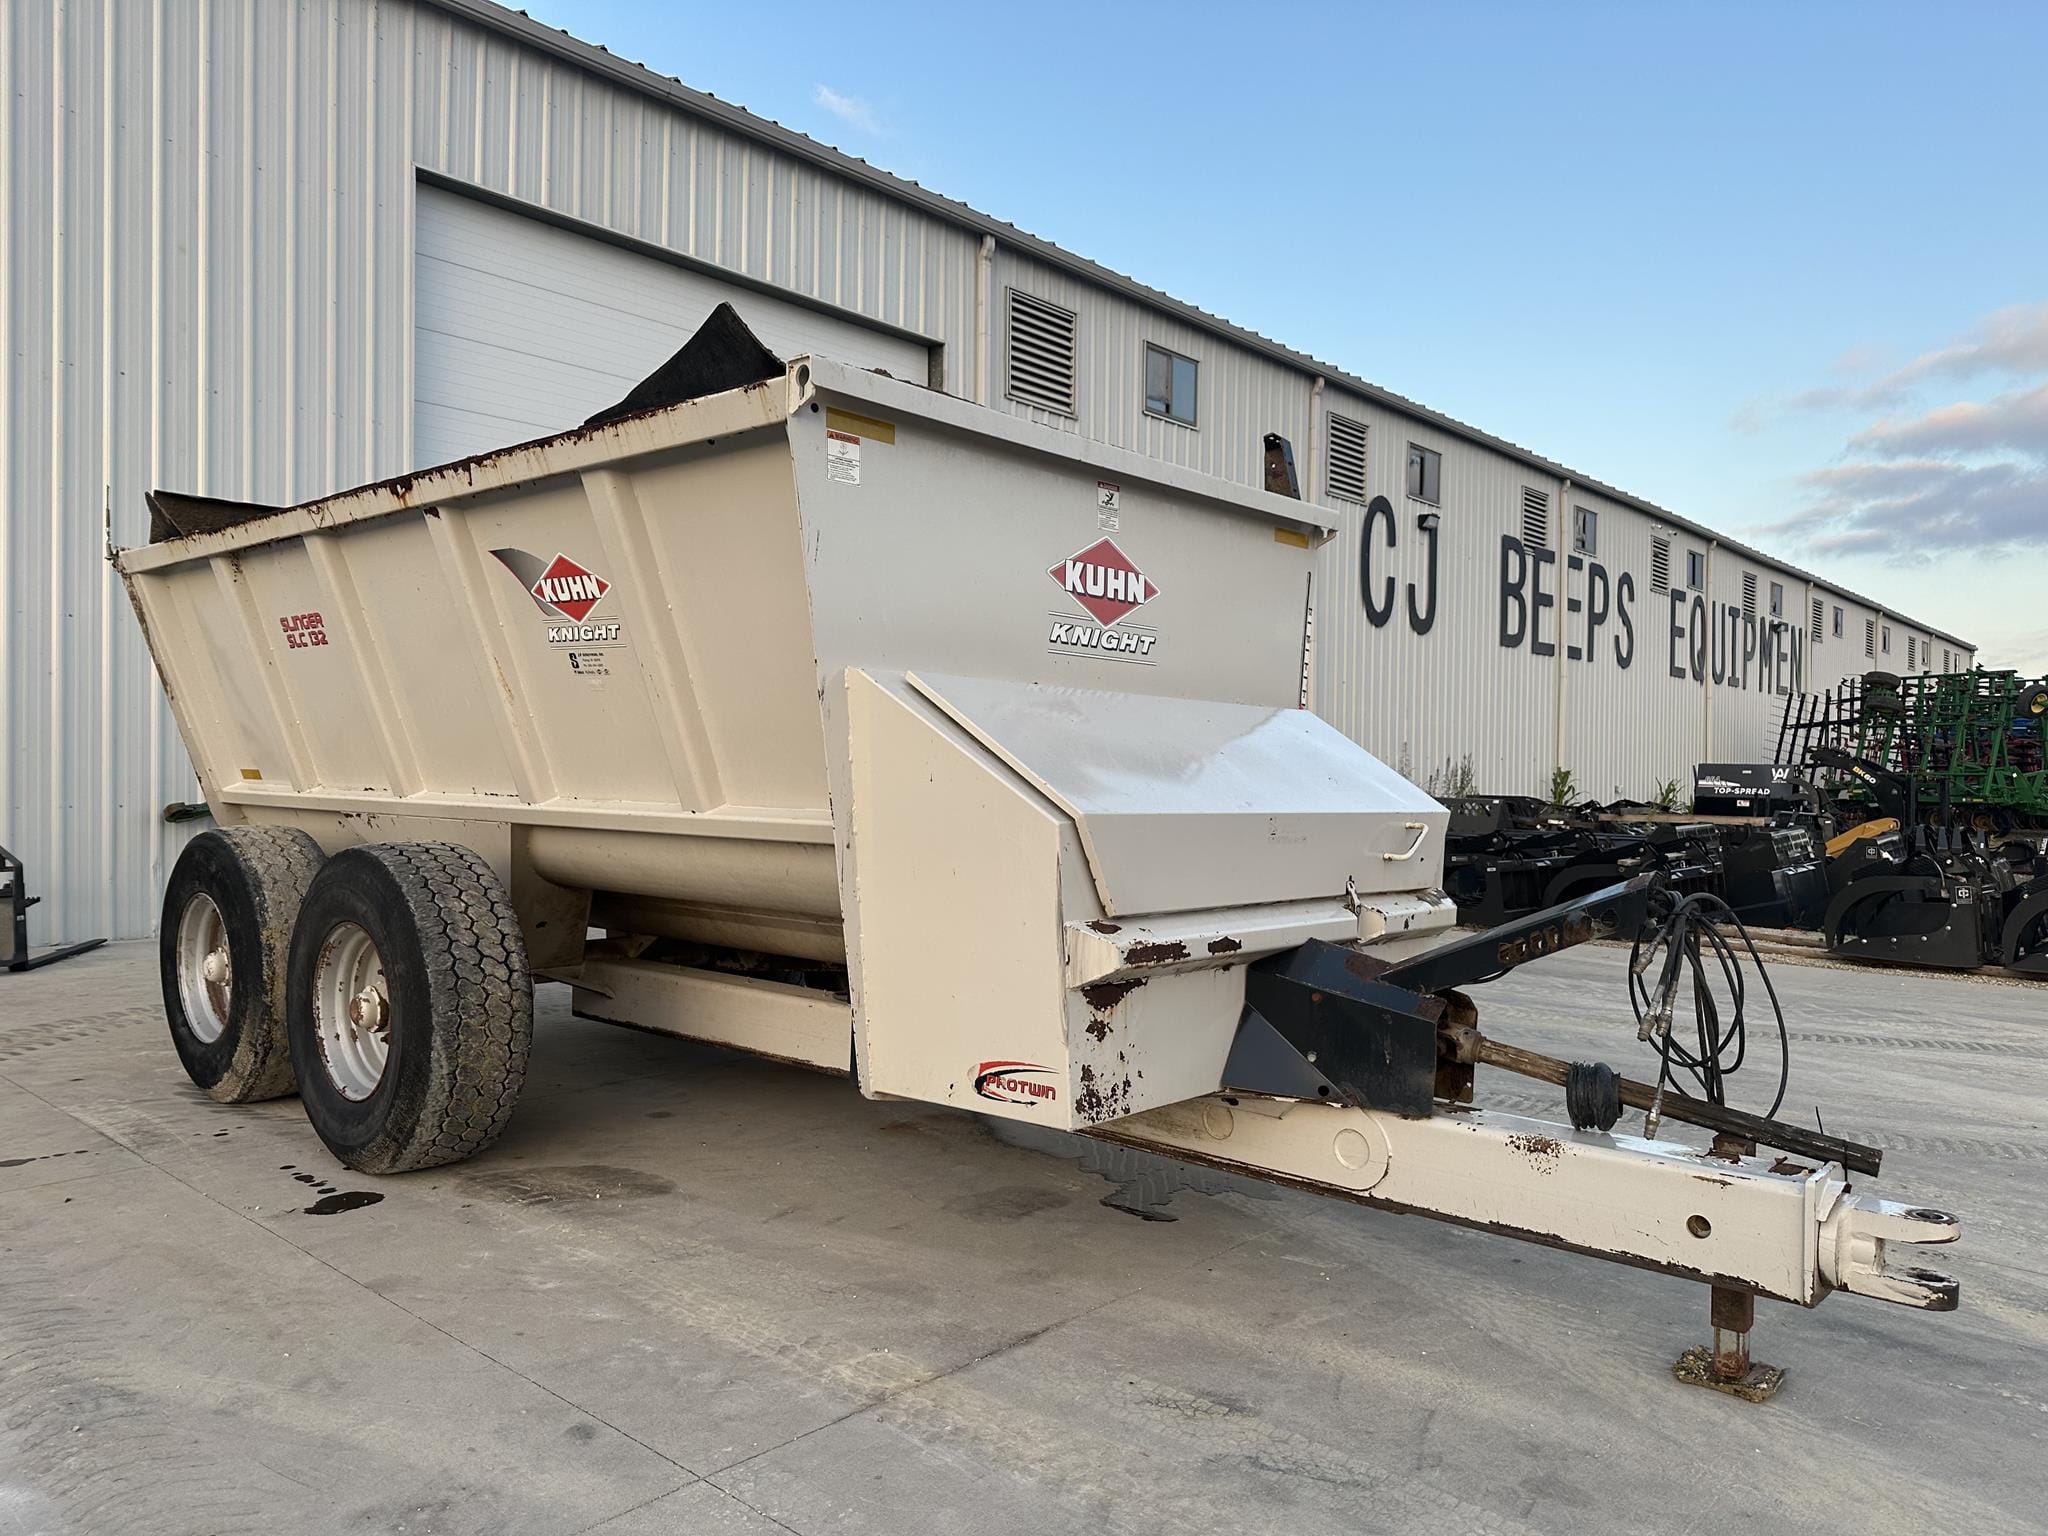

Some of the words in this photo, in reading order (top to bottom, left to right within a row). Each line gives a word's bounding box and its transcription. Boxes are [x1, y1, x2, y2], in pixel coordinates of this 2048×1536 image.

[540, 574, 602, 604] KUHN
[1064, 559, 1146, 605] KUHN
[280, 612, 324, 632] SLINGER
[1500, 534, 1634, 669] BEEPS
[1669, 587, 1816, 699] EQUIPMEN
[287, 632, 308, 649] SLC
[308, 630, 328, 646] 132
[548, 624, 620, 643] KNIGHT
[1049, 622, 1157, 655] KNIGHT
[1714, 787, 1770, 796] TOP-SPREAD
[985, 1074, 1056, 1101] PROTWIN
